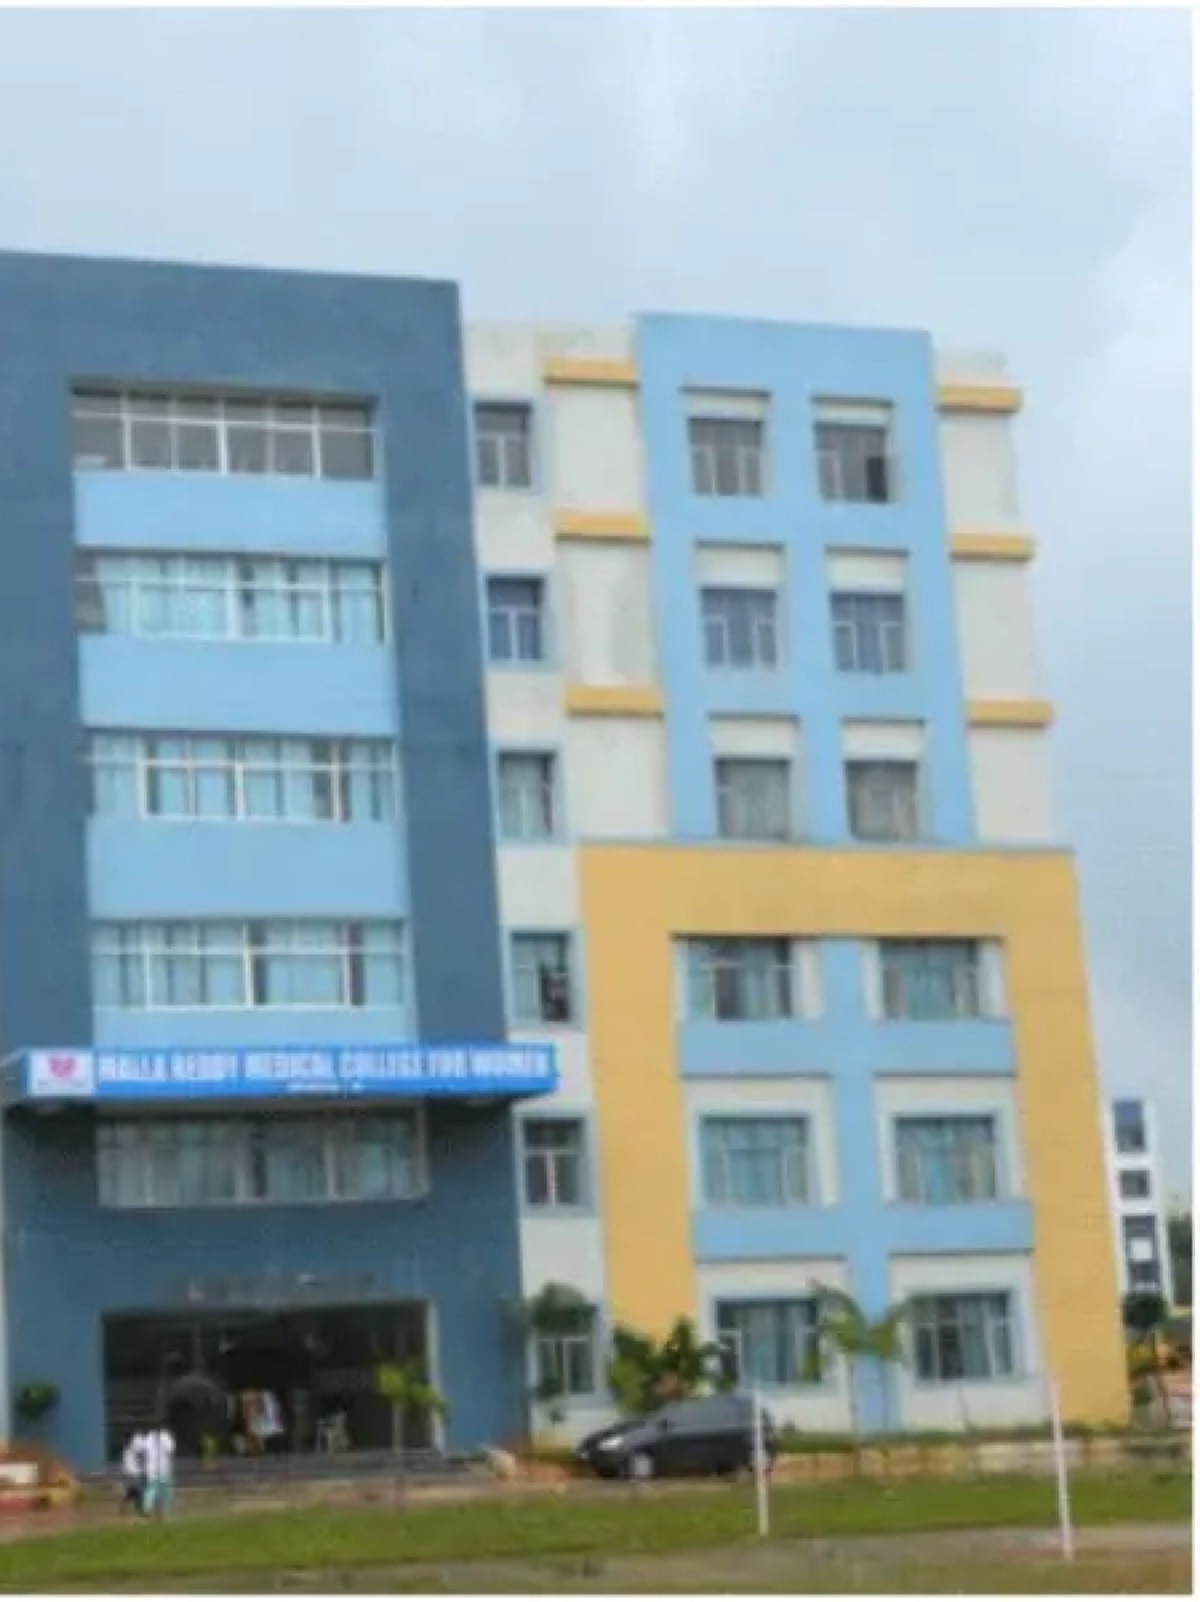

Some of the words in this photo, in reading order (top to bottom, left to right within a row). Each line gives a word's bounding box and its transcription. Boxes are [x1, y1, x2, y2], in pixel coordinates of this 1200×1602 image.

[246, 1052, 334, 1080] MEDICAL
[339, 1051, 422, 1079] COLLEGE
[428, 1050, 467, 1078] FOR
[471, 1050, 549, 1078] WOMEN
